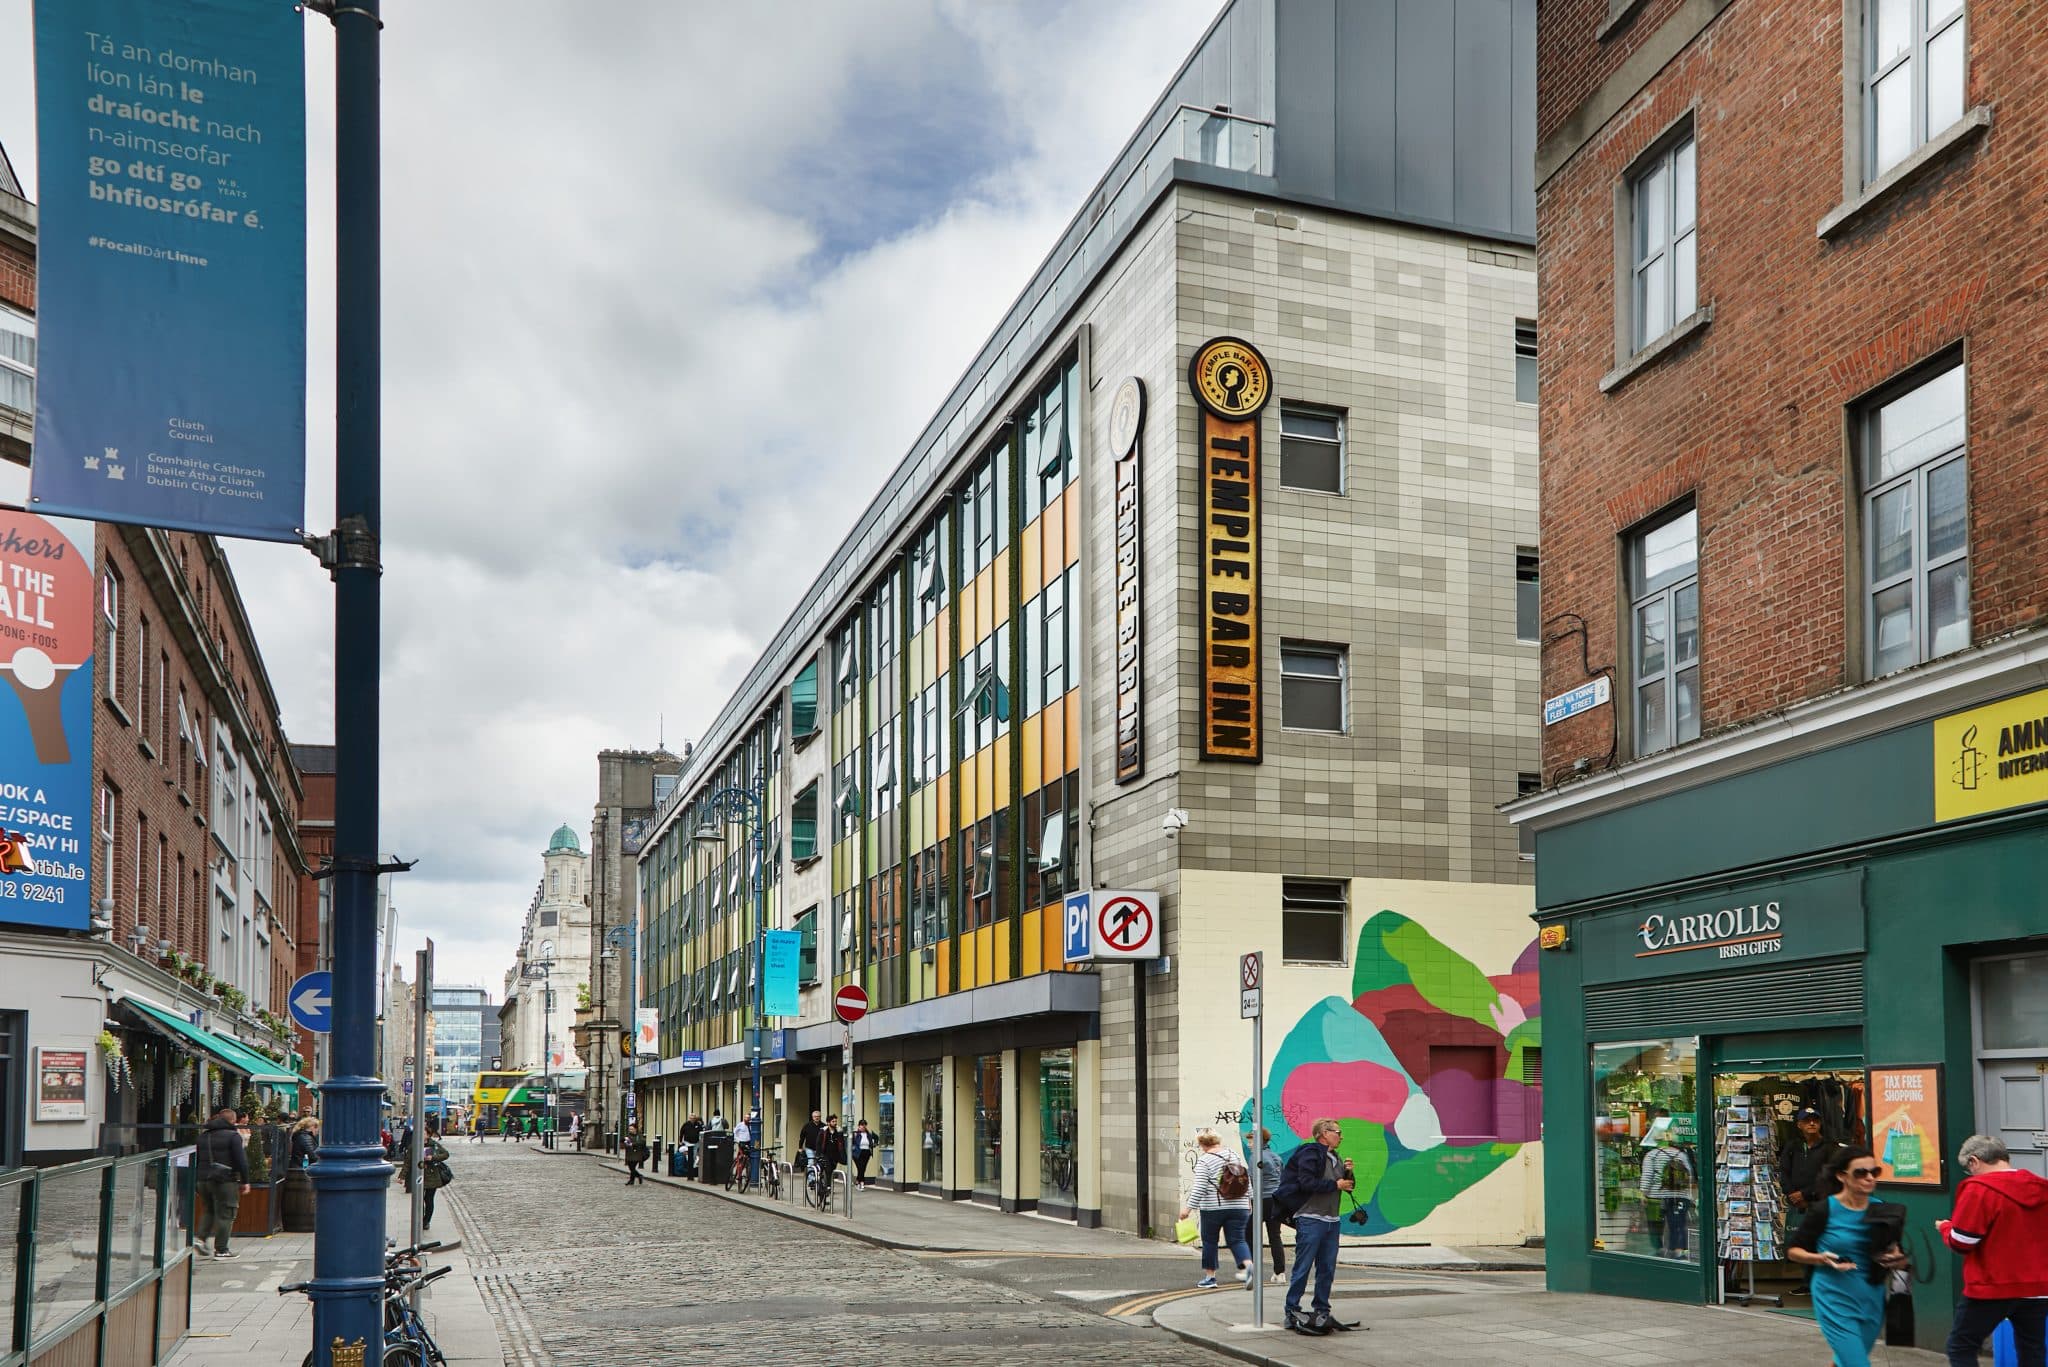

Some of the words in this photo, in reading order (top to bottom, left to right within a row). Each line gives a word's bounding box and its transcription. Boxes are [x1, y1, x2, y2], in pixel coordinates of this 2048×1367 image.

[85, 31, 114, 56] Tá
[122, 44, 151, 64] an
[158, 49, 257, 85] domhan
[87, 61, 131, 89] líon
[138, 72, 174, 98] lán
[181, 81, 204, 104] le
[88, 94, 200, 133] draíocht
[206, 120, 262, 145] nach
[88, 126, 232, 167] n-aimseofar
[88, 156, 122, 177] go
[127, 160, 165, 183] dtí
[170, 171, 202, 193] go
[89, 180, 238, 225] bhfiosrófar
[243, 209, 264, 230] é.
[217, 187, 248, 199] YEATS
[88, 235, 209, 267] #FocailDárLinne
[1205, 351, 1231, 379] TEMPLE
[1232, 351, 1253, 368] BAR
[1249, 367, 1261, 386] INN
[168, 417, 205, 432] Cliath
[168, 429, 214, 444] Council
[147, 453, 210, 470] Comhairle
[213, 462, 265, 479] Cathrach
[147, 464, 186, 478] Bhaile
[219, 473, 255, 488] Cliath
[146, 475, 188, 490] Dublin
[191, 481, 216, 495] City
[218, 486, 264, 501] Council
[1211, 435, 1250, 581] TEMPLE
[1118, 463, 1137, 613] TEMPLE
[9, 563, 55, 598] THE
[32, 632, 59, 650] FOOS
[1211, 589, 1250, 669] BAR
[1119, 623, 1137, 697] BAR
[1212, 681, 1251, 750] INN
[1549, 707, 1567, 720] FLEET
[1570, 697, 1593, 711] STREET
[1119, 702, 1138, 771] INN
[33, 789, 47, 805] A
[24, 831, 58, 851] SAY
[61, 837, 79, 854] HI
[22, 883, 65, 904] 9241
[1068, 905, 1080, 951] P
[1637, 901, 1781, 950] CARROLLS
[1719, 943, 1748, 959] IRISH
[1749, 938, 1781, 955] GIFTS
[1884, 1075, 1901, 1089] TAX
[1902, 1075, 1923, 1089] FREE
[1884, 1089, 1923, 1102] SHOPPING
